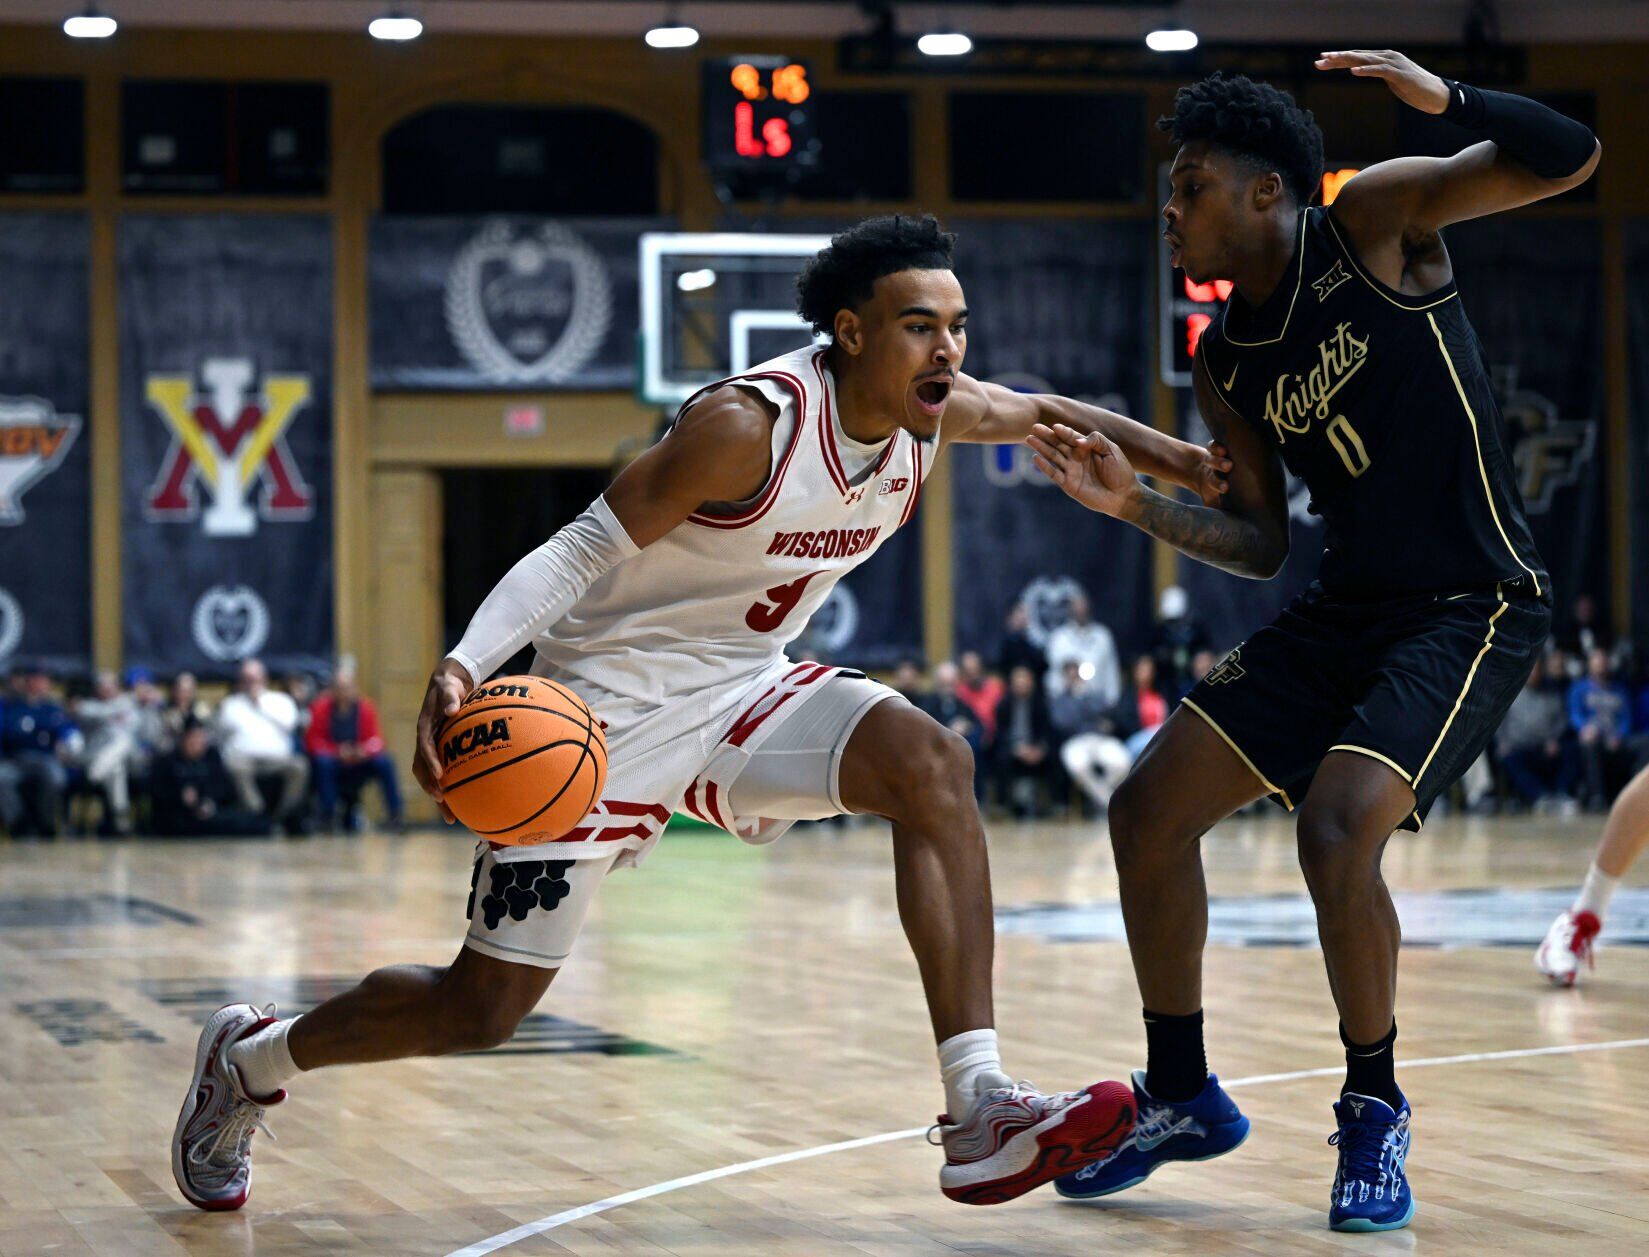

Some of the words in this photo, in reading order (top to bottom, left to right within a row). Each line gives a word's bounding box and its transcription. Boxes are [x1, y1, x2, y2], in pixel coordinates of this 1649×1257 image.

[1263, 321, 1370, 444] Knights
[1325, 413, 1371, 479] 0
[765, 525, 882, 558] WISCONSIN
[443, 718, 511, 767] NCAA
[490, 742, 513, 752] BALL
